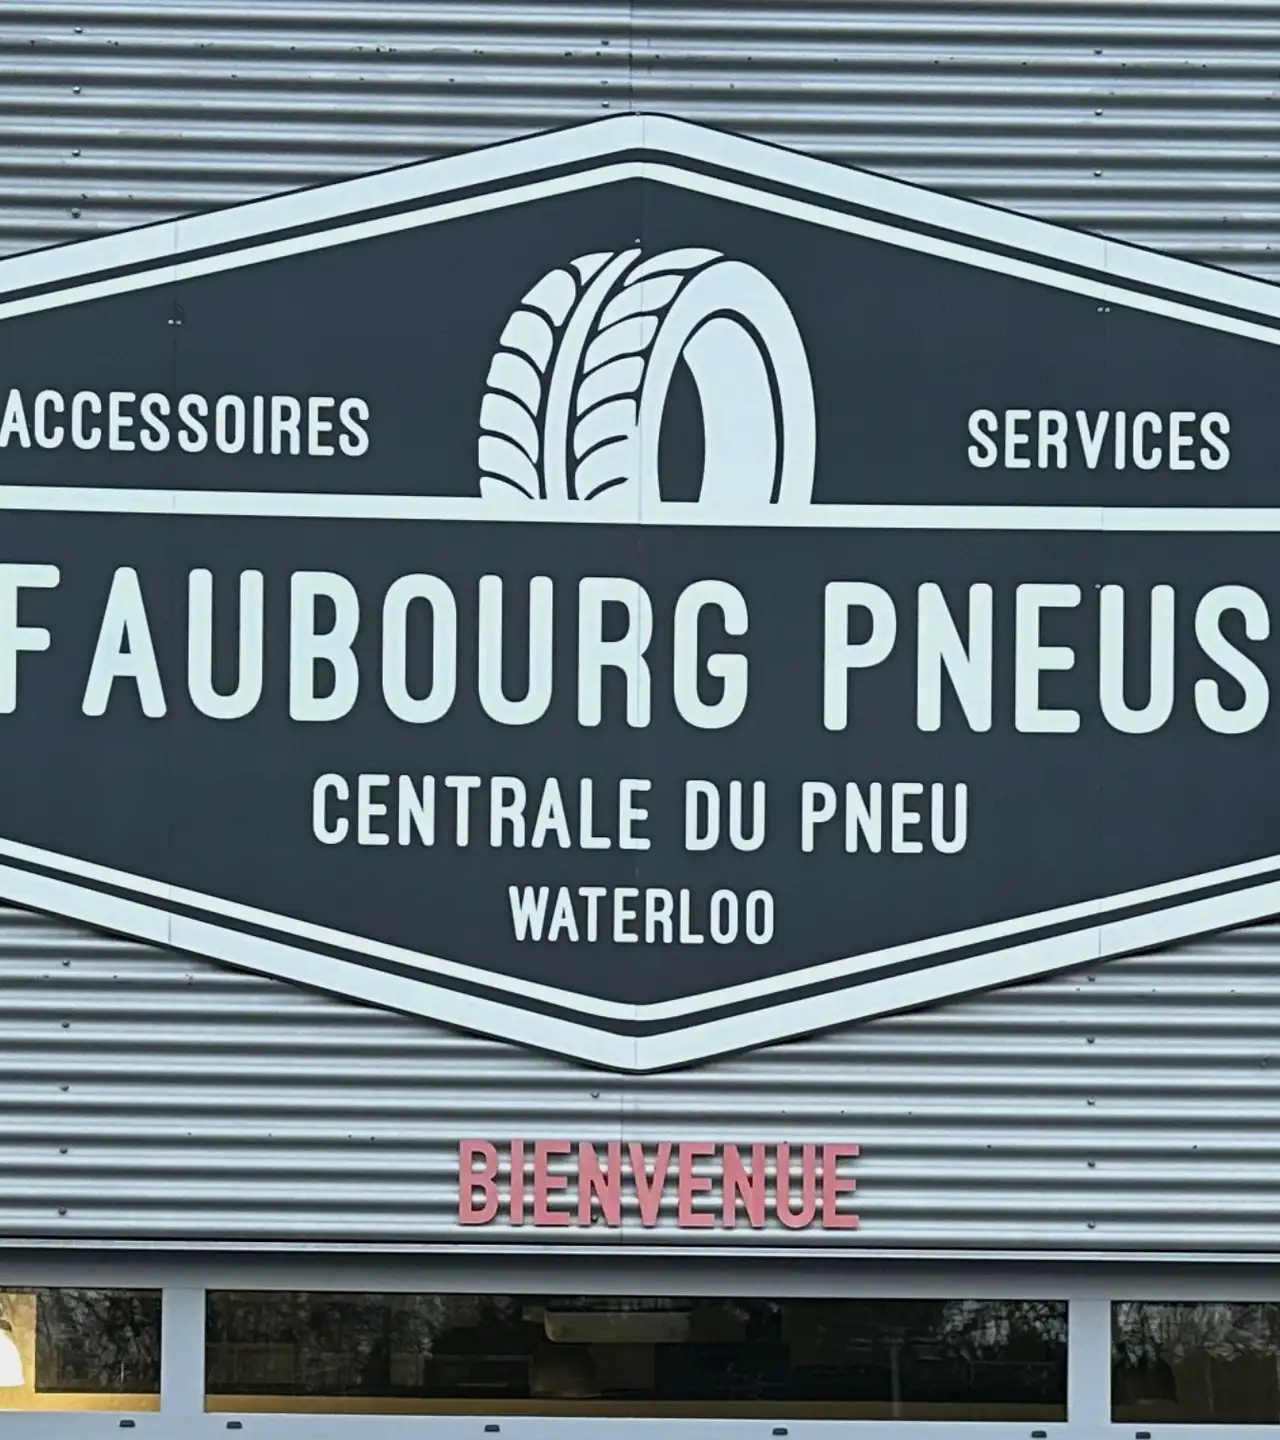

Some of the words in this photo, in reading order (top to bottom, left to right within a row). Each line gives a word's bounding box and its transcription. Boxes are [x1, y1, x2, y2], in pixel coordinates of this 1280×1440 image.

[967, 409, 1230, 471] SERVICES
[823, 581, 1270, 734] PNEUS
[312, 773, 652, 850] CENTRALE
[685, 779, 766, 852] DU
[801, 781, 968, 854] PNEU
[508, 885, 774, 945] WATERLOO
[458, 1138, 860, 1229] BIENVENUE
